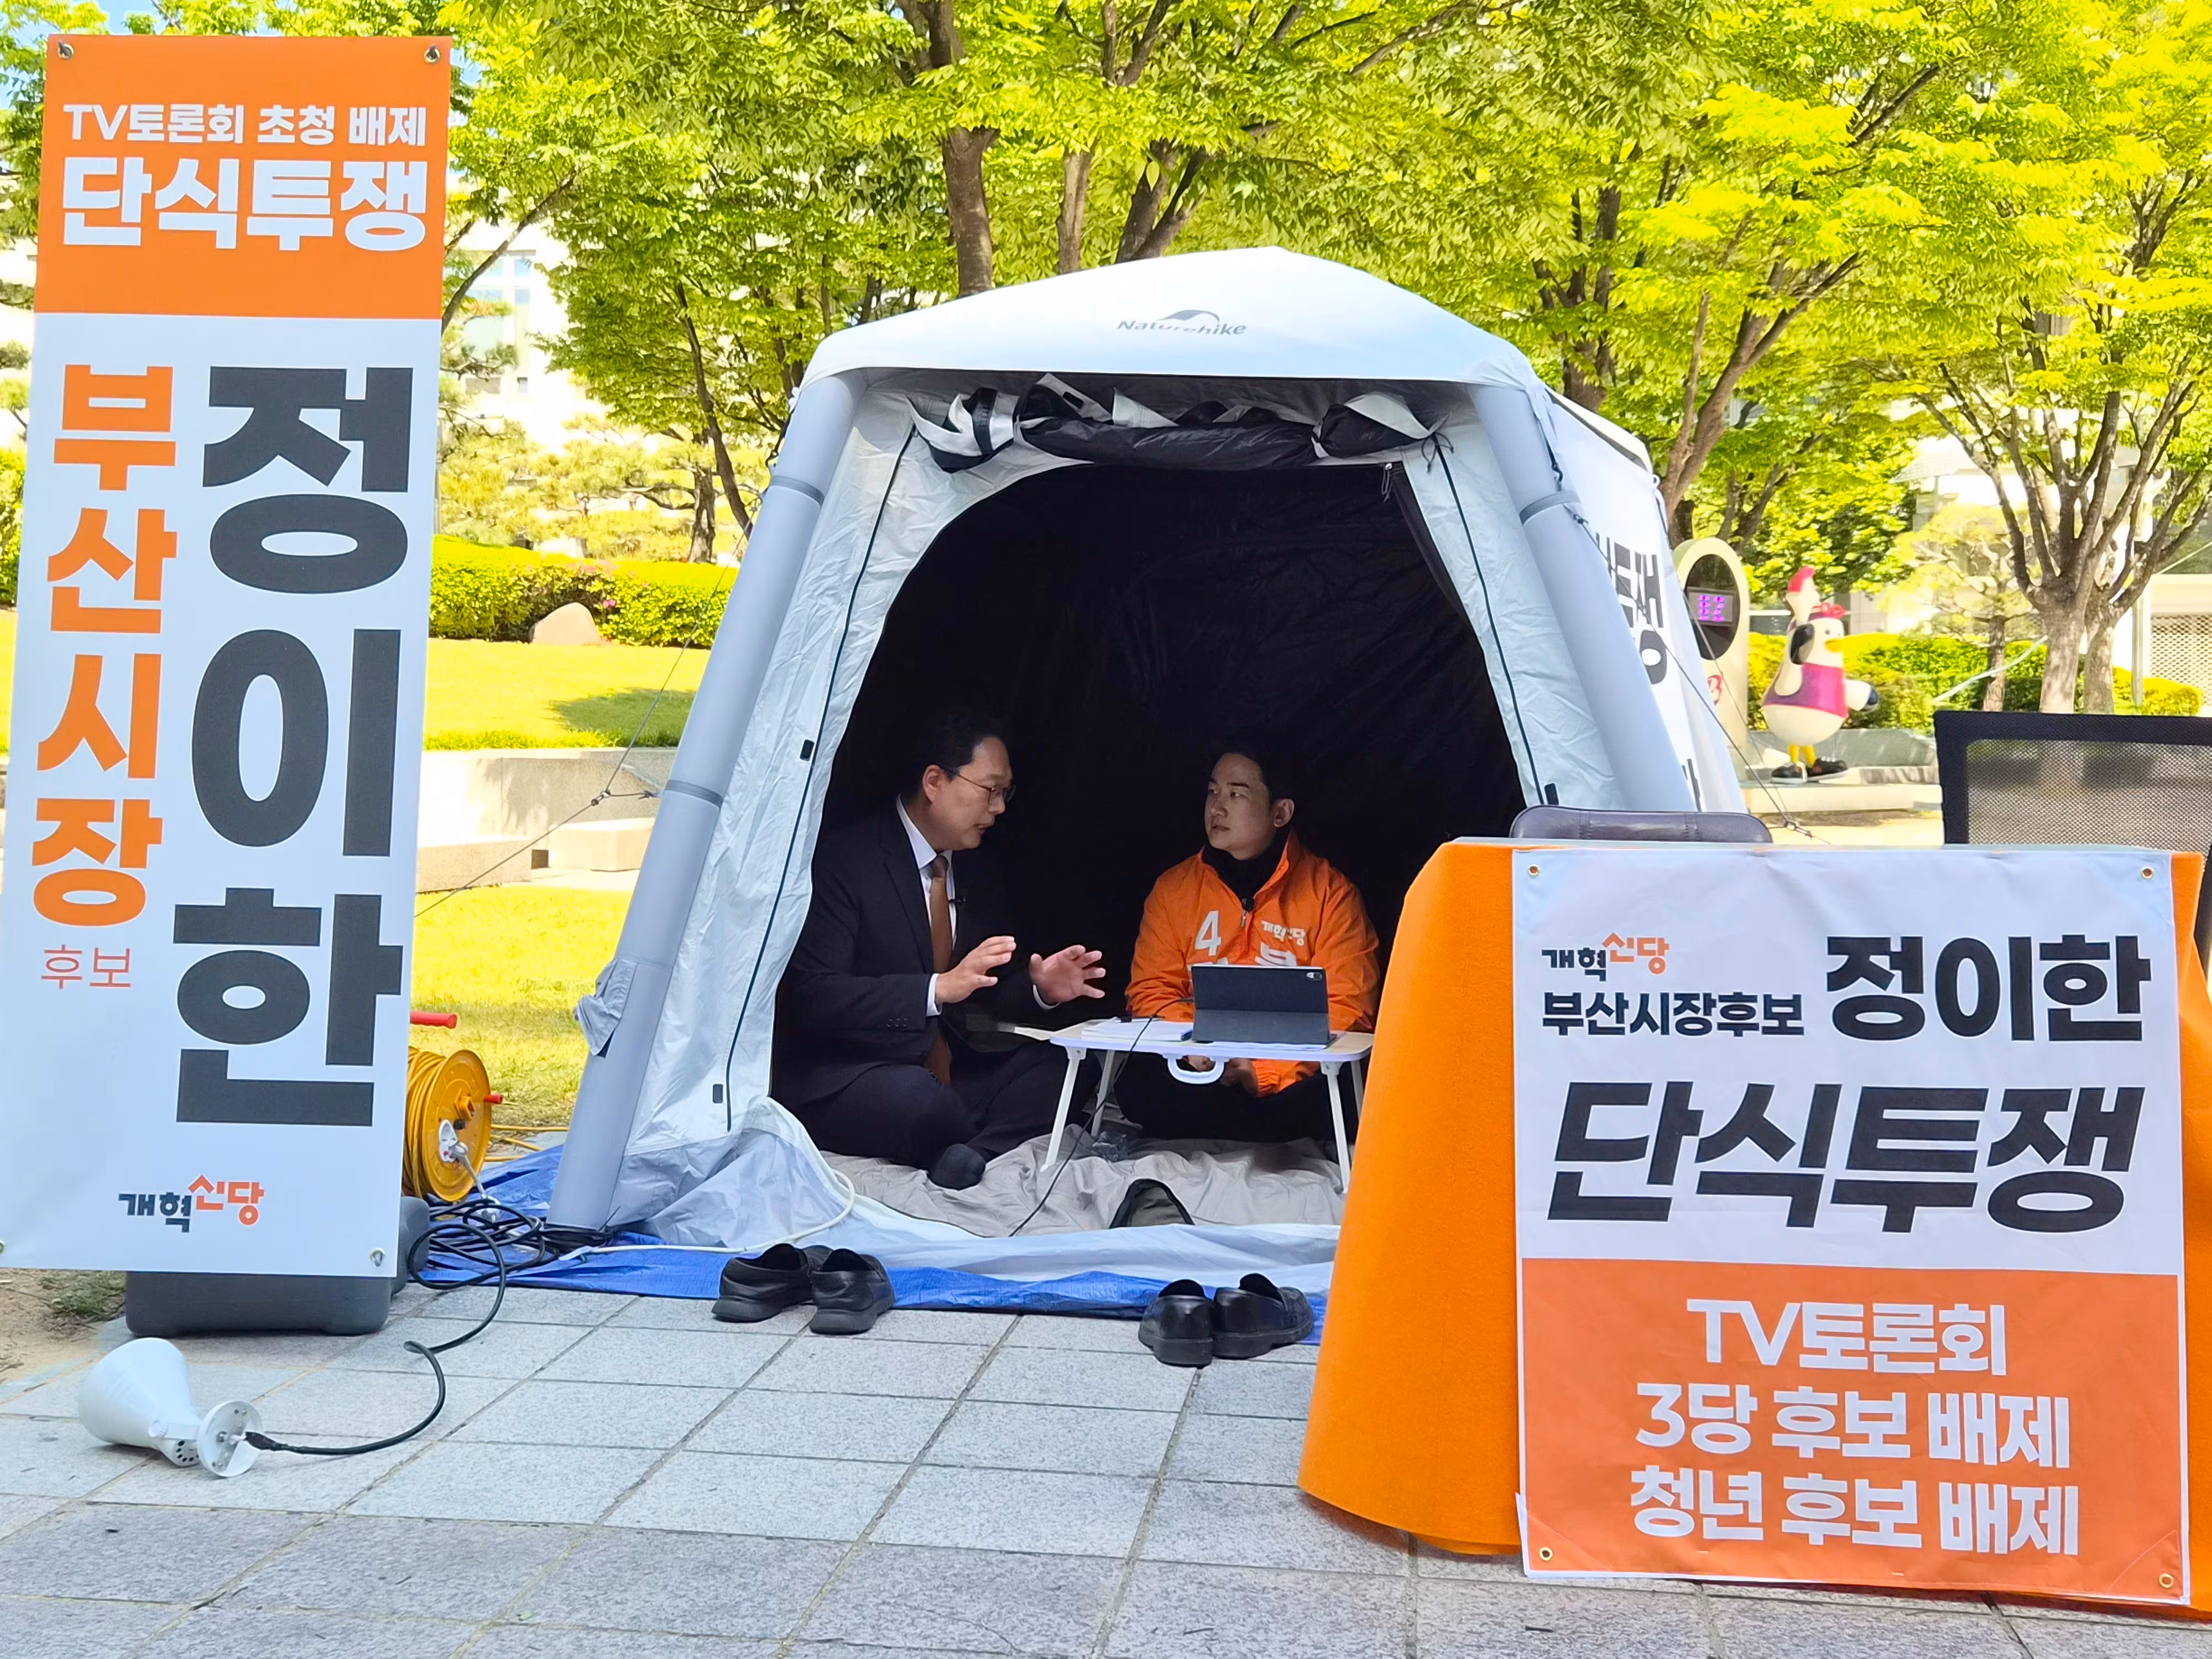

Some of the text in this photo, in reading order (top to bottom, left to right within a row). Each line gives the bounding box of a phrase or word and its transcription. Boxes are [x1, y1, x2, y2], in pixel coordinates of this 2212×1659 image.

[63, 104, 426, 147] TV토론회 초청 배제
[62, 156, 427, 252] 단식투쟁
[1117, 320, 1247, 336] Naturehike
[32, 364, 178, 927] 부산시장
[173, 366, 414, 1127] 정이한
[41, 945, 132, 990] 후보
[1195, 910, 1222, 956] 4
[1541, 931, 1670, 982] 개혁신당
[1542, 934, 2152, 1042] 부산시장후보 정이한
[1547, 1081, 2146, 1234] 단식투쟁
[118, 1174, 265, 1233] 개혁신당
[1686, 1298, 2007, 1376] TV토론회
[1634, 1382, 2071, 1469] 3당 후보 배제
[1630, 1465, 2079, 1556] 청년 후보 배제
